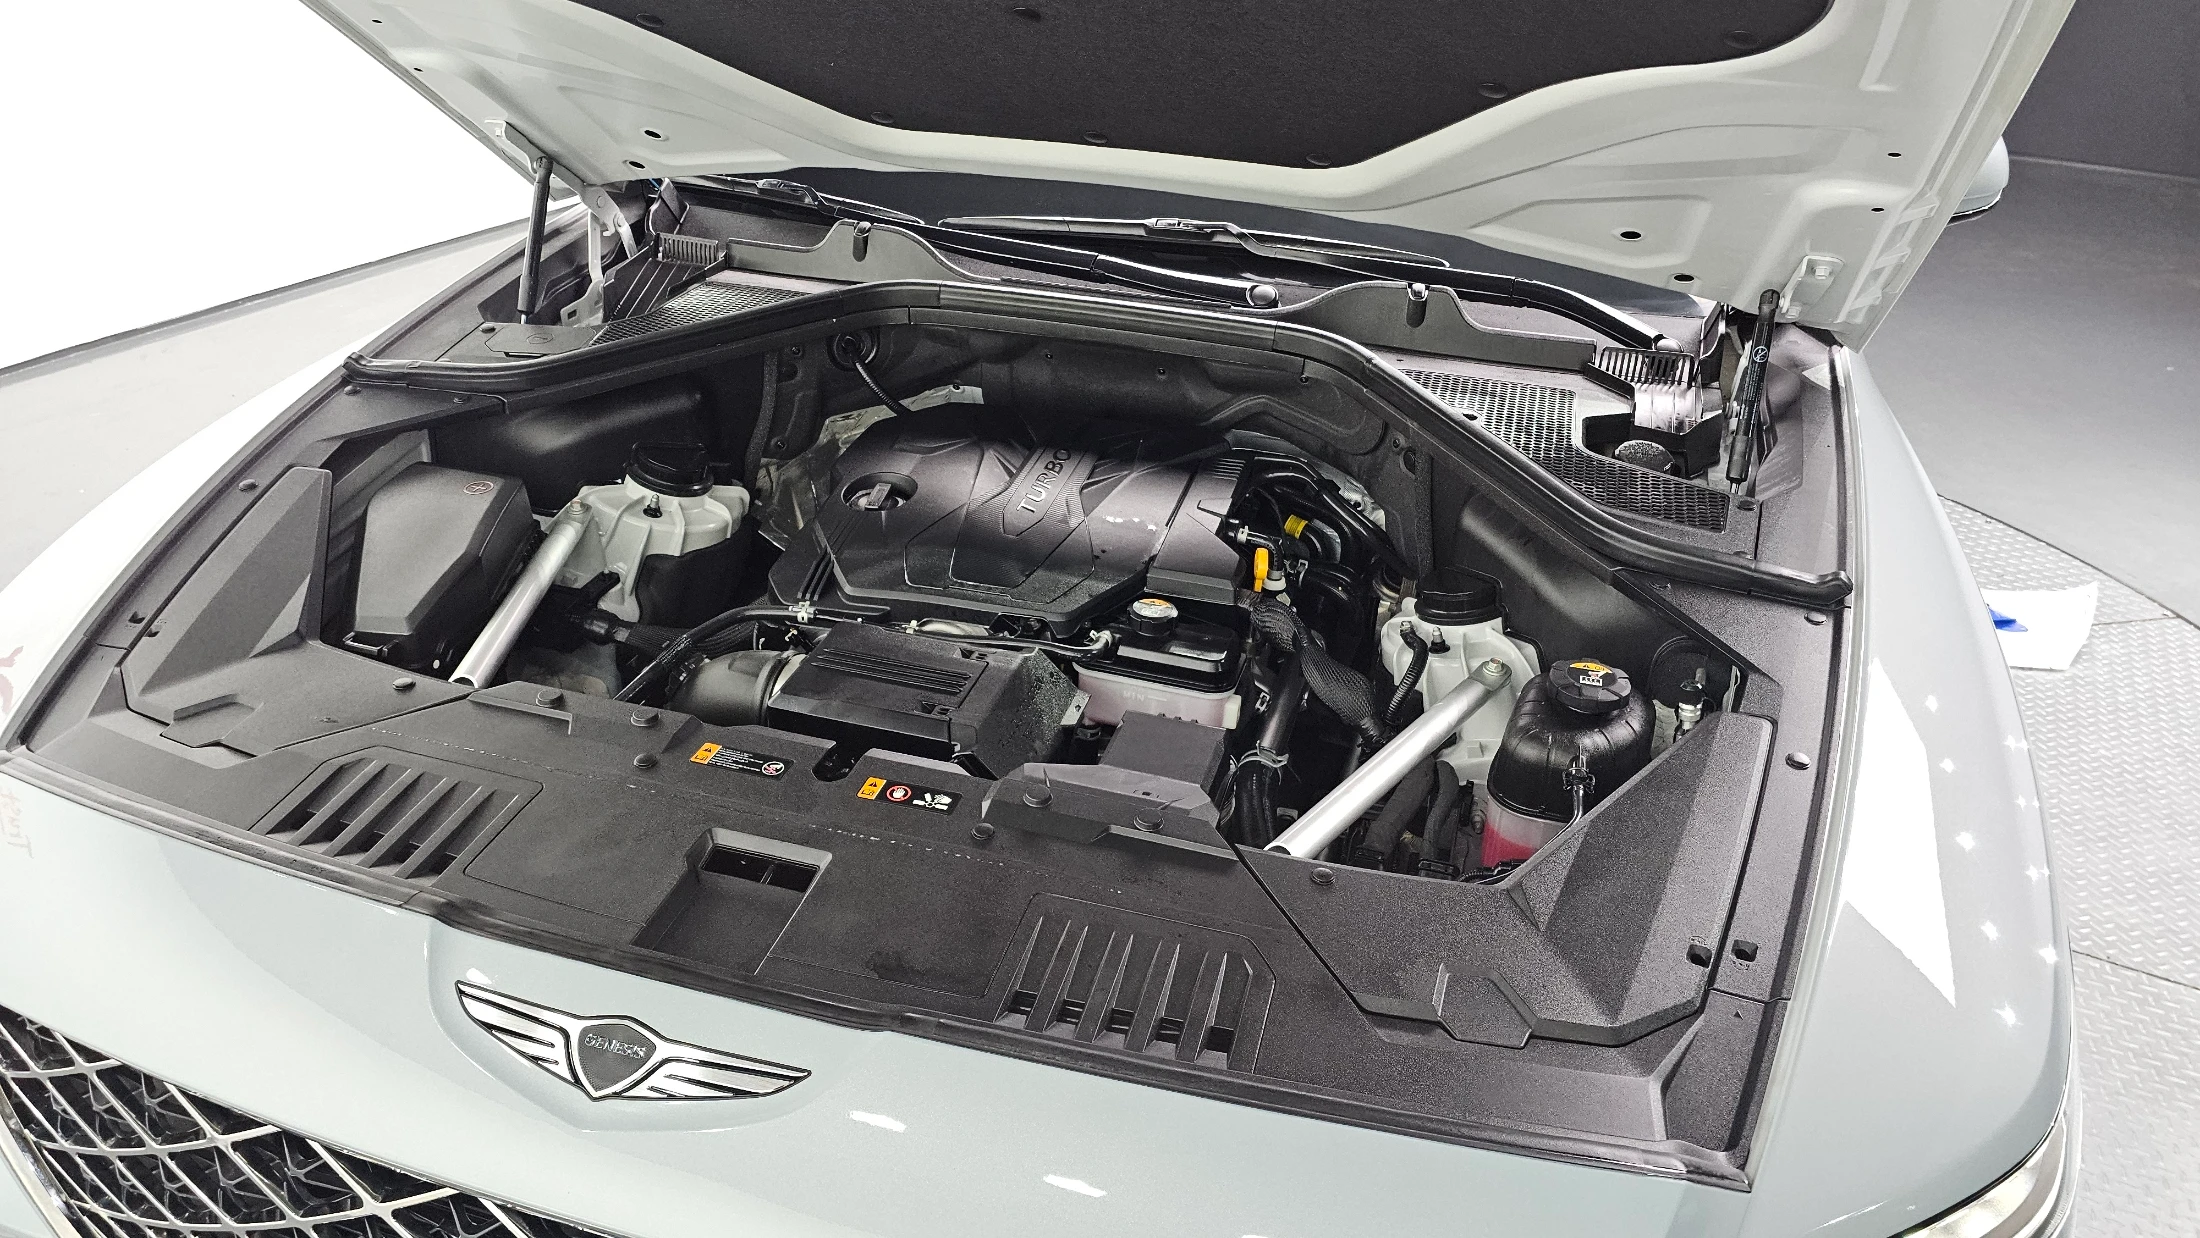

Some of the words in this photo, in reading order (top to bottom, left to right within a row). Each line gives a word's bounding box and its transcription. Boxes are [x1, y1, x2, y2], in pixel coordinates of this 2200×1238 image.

[1016, 448, 1072, 514] TURBO
[1122, 690, 1145, 702] MIN
[584, 1033, 646, 1059] GENESIS
